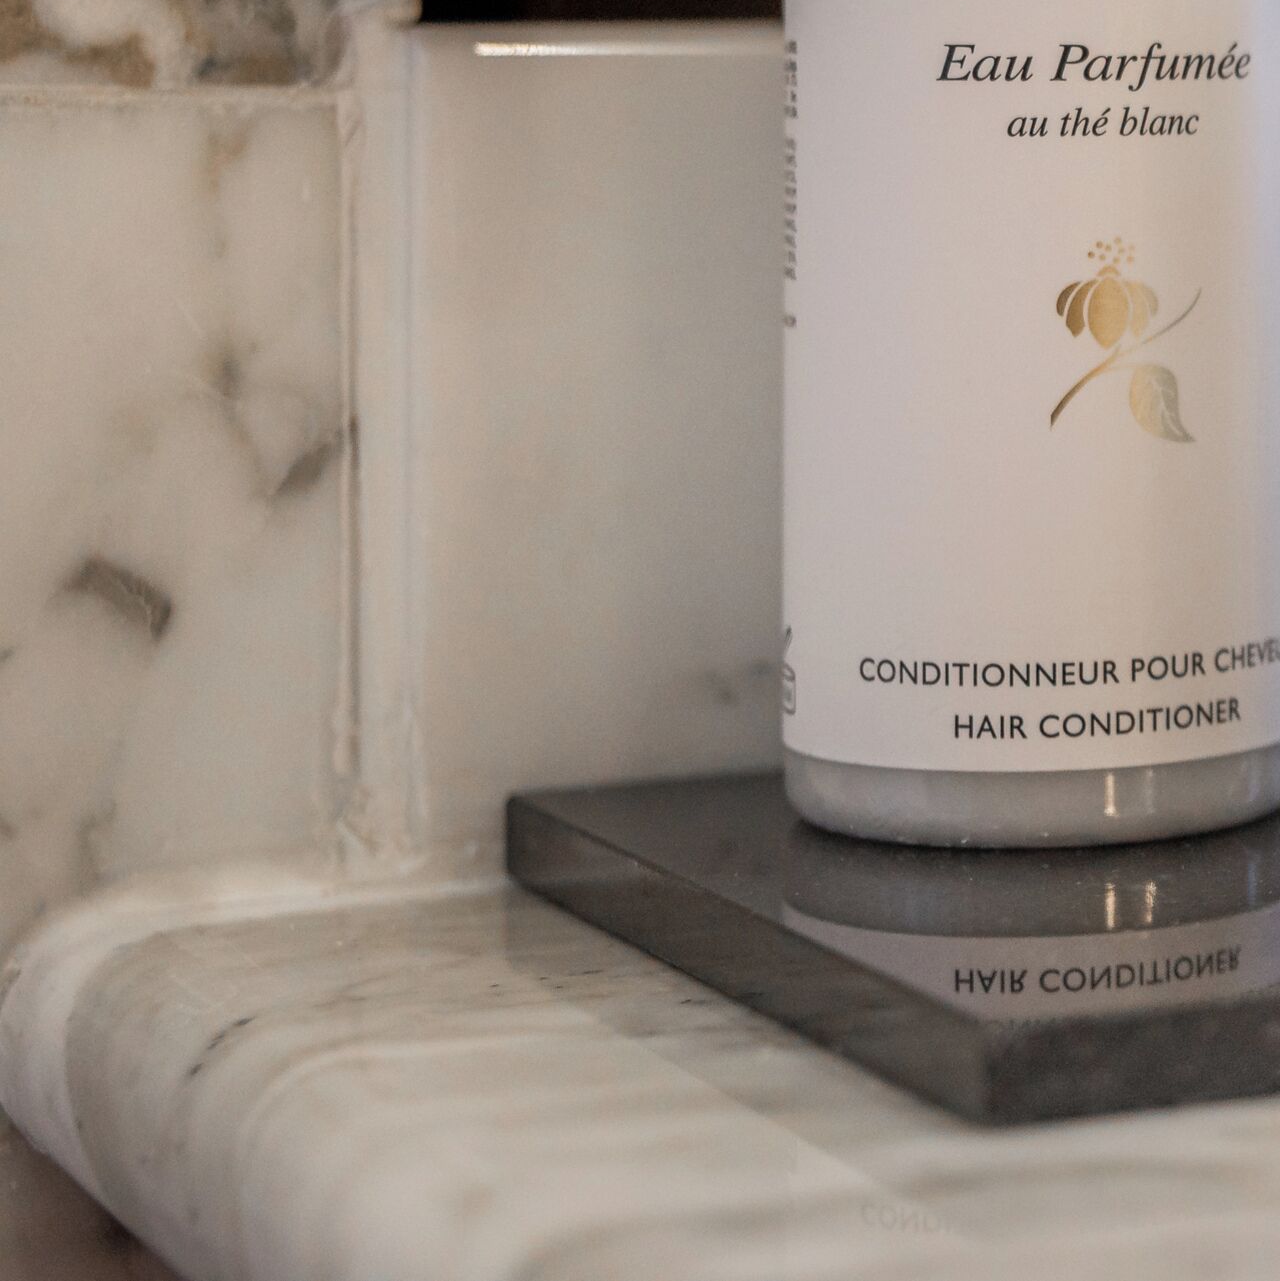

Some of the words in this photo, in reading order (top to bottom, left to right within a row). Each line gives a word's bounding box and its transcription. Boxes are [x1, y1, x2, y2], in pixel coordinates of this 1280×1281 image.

[935, 42, 1034, 82] Eau
[1050, 41, 1252, 92] Parfumée
[1006, 113, 1048, 137] au
[1060, 107, 1111, 137] thé
[1119, 106, 1200, 137] blanc
[858, 657, 1121, 687] CONDITIONNEUR
[1130, 652, 1207, 683] POUR
[953, 714, 1027, 740] HAIR
[1038, 697, 1241, 739] CONDITIONER
